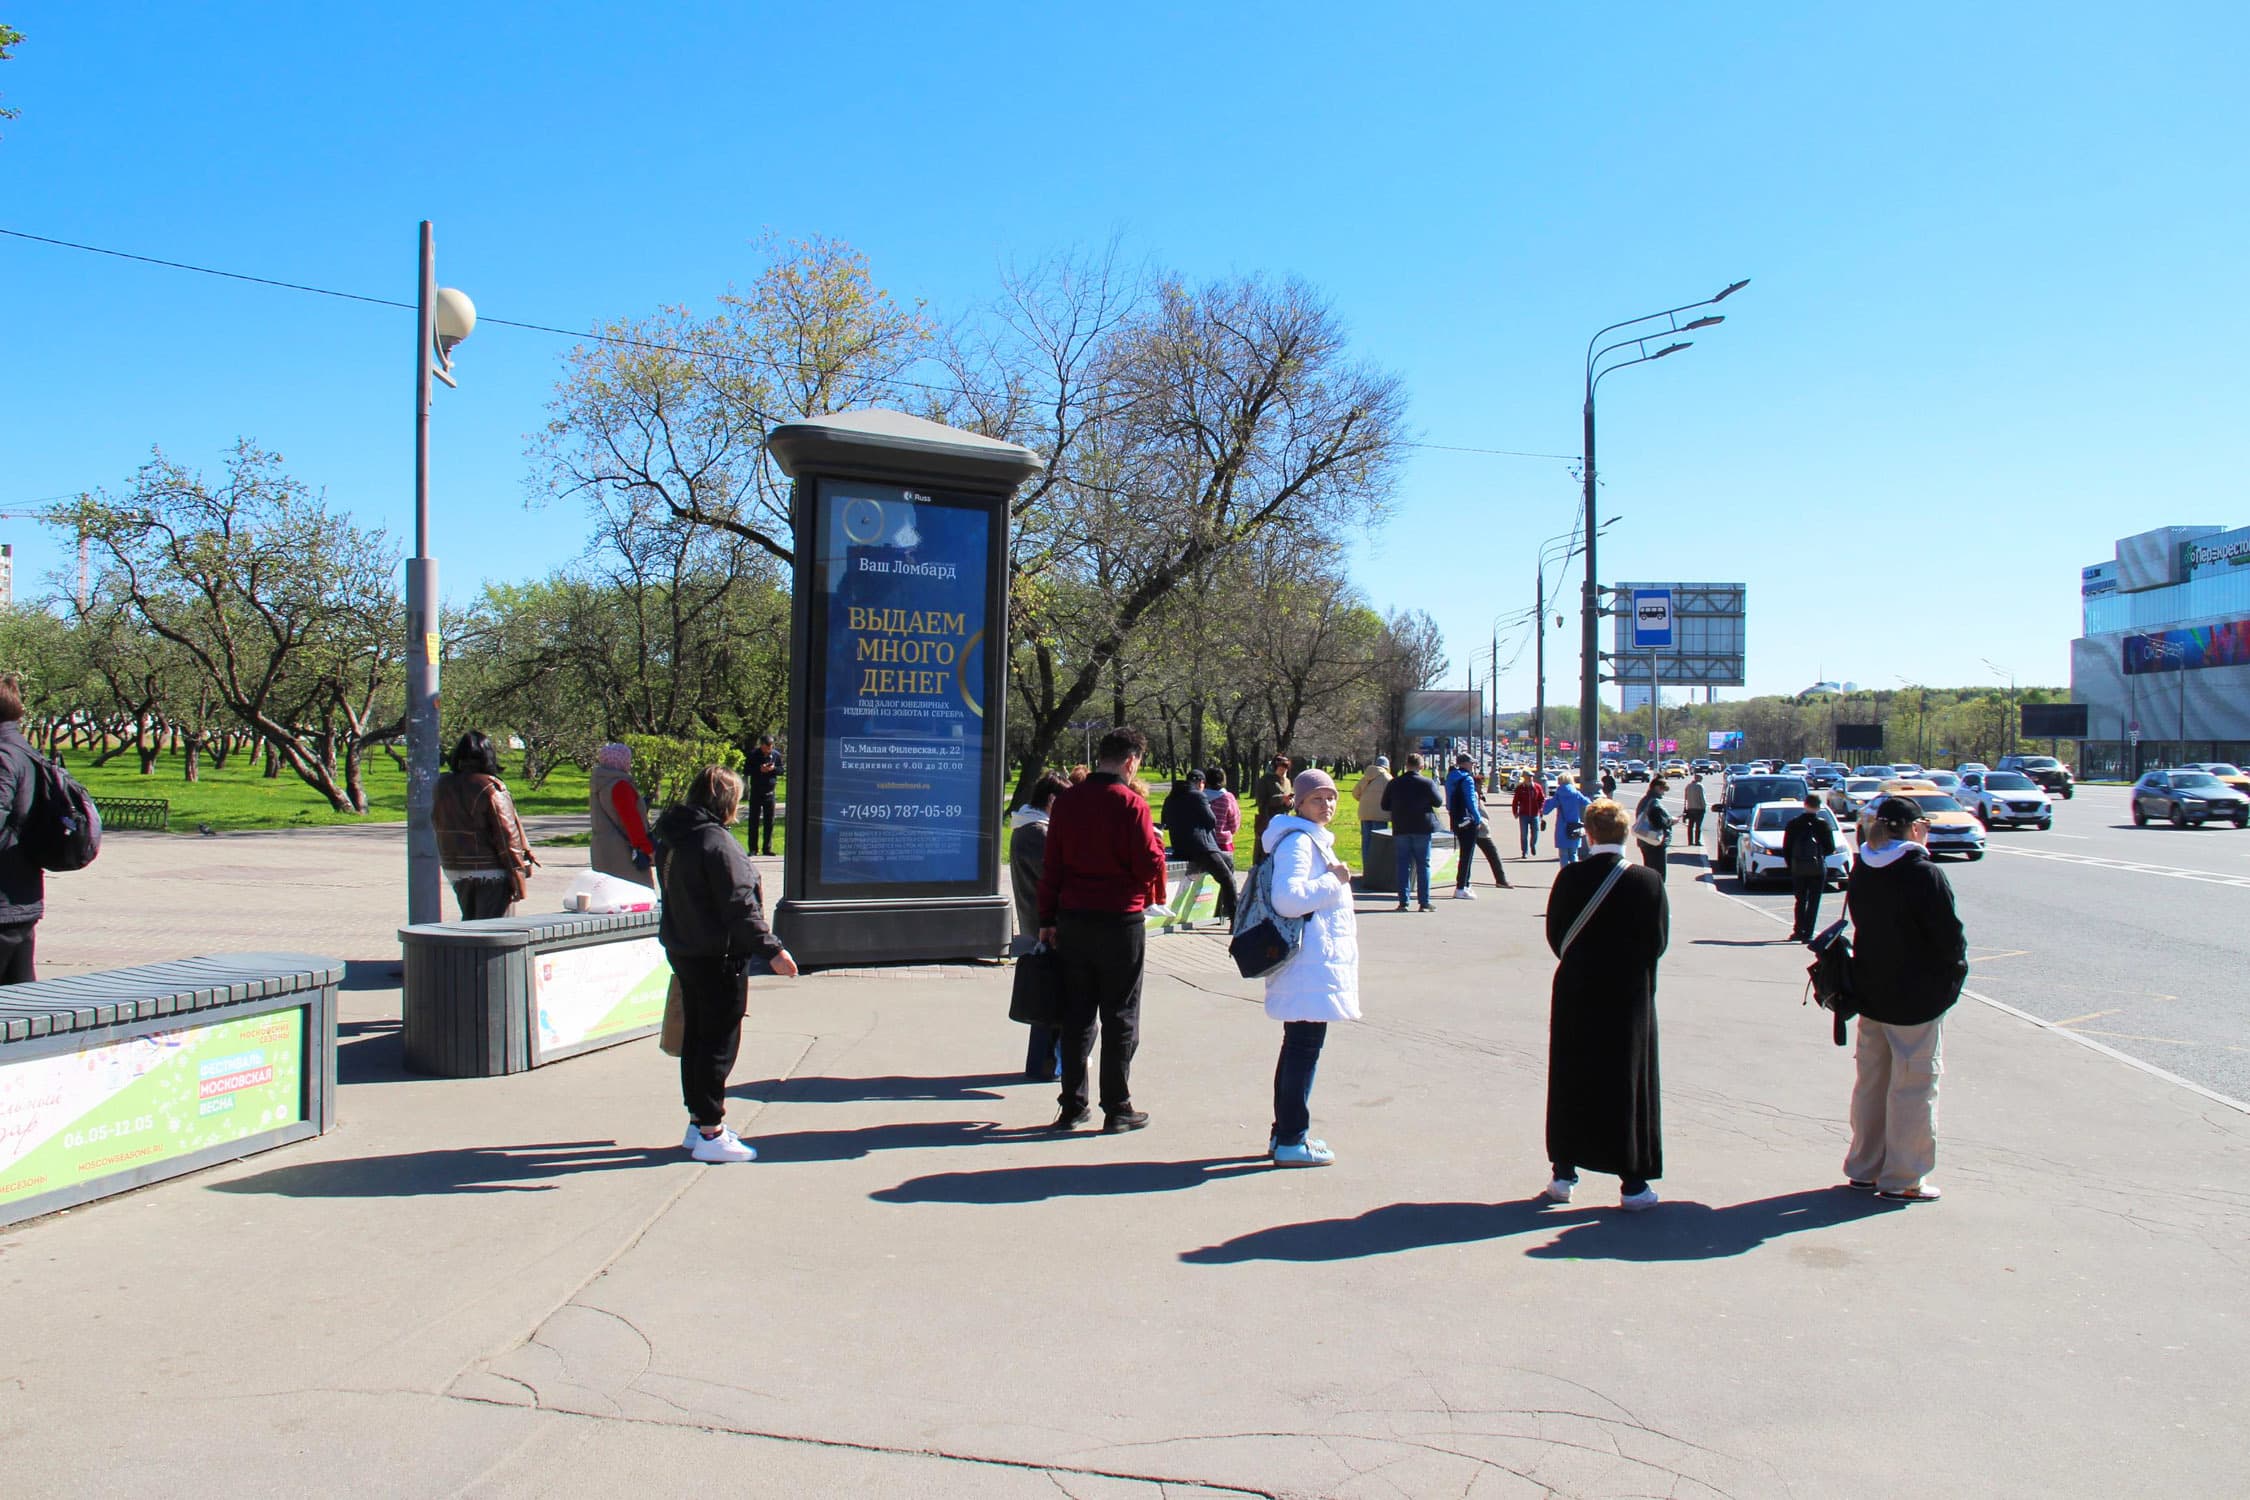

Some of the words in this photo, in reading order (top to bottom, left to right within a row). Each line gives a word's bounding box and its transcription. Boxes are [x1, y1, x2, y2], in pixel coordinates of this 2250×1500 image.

[914, 493, 931, 502] Russ
[859, 557, 889, 573] Ваш
[892, 560, 956, 580] Ломбард
[848, 606, 966, 637] ВЫДАЕМ
[856, 638, 955, 665] МНОГО
[859, 669, 950, 697] ДЕНЕГ
[843, 707, 879, 716] ИЗДЕЛИЙ
[880, 708, 891, 717] ИЗ
[893, 709, 922, 717] ЗОЛОТА
[931, 710, 964, 718] СЕРЕБРА
[858, 699, 875, 708] ПОД
[876, 700, 899, 709] ЗАЛОГ
[901, 701, 950, 710] ЮВЕЛИРНЫХ
[844, 744, 857, 753] Ул.
[858, 744, 887, 753] Малая
[938, 747, 948, 756] д.
[949, 746, 961, 755] 22
[842, 761, 893, 770] Ежедневно
[840, 805, 891, 820] +7(495)
[894, 805, 962, 818] 787-05-89
[200, 1053, 263, 1076] ФЕСТИВАЛЬ
[200, 1067, 272, 1096] МОСКОВСКАЯ
[200, 1097, 233, 1115] ВЕСНА
[64, 1115, 153, 1148] 06.05-12.05
